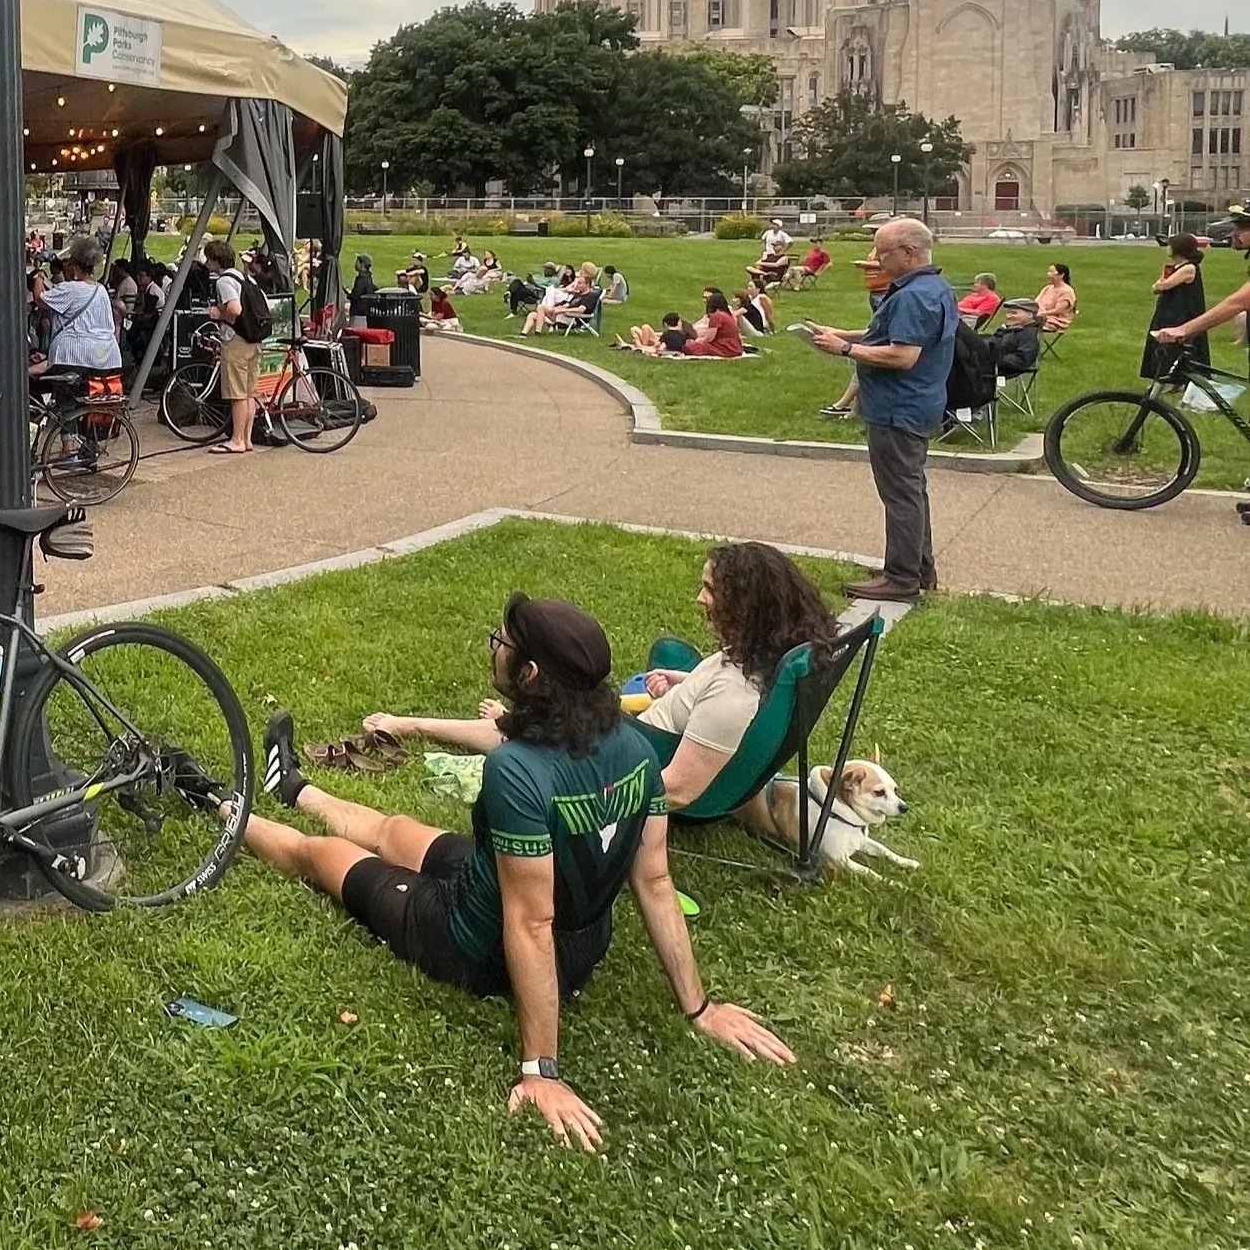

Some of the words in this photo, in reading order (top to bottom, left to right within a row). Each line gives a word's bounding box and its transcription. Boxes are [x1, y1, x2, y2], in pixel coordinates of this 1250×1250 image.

[113, 25, 148, 43] Pittsburgh
[113, 37, 132, 50] Parks
[111, 49, 155, 67] Conservancy
[196, 862, 217, 886] SWISS
